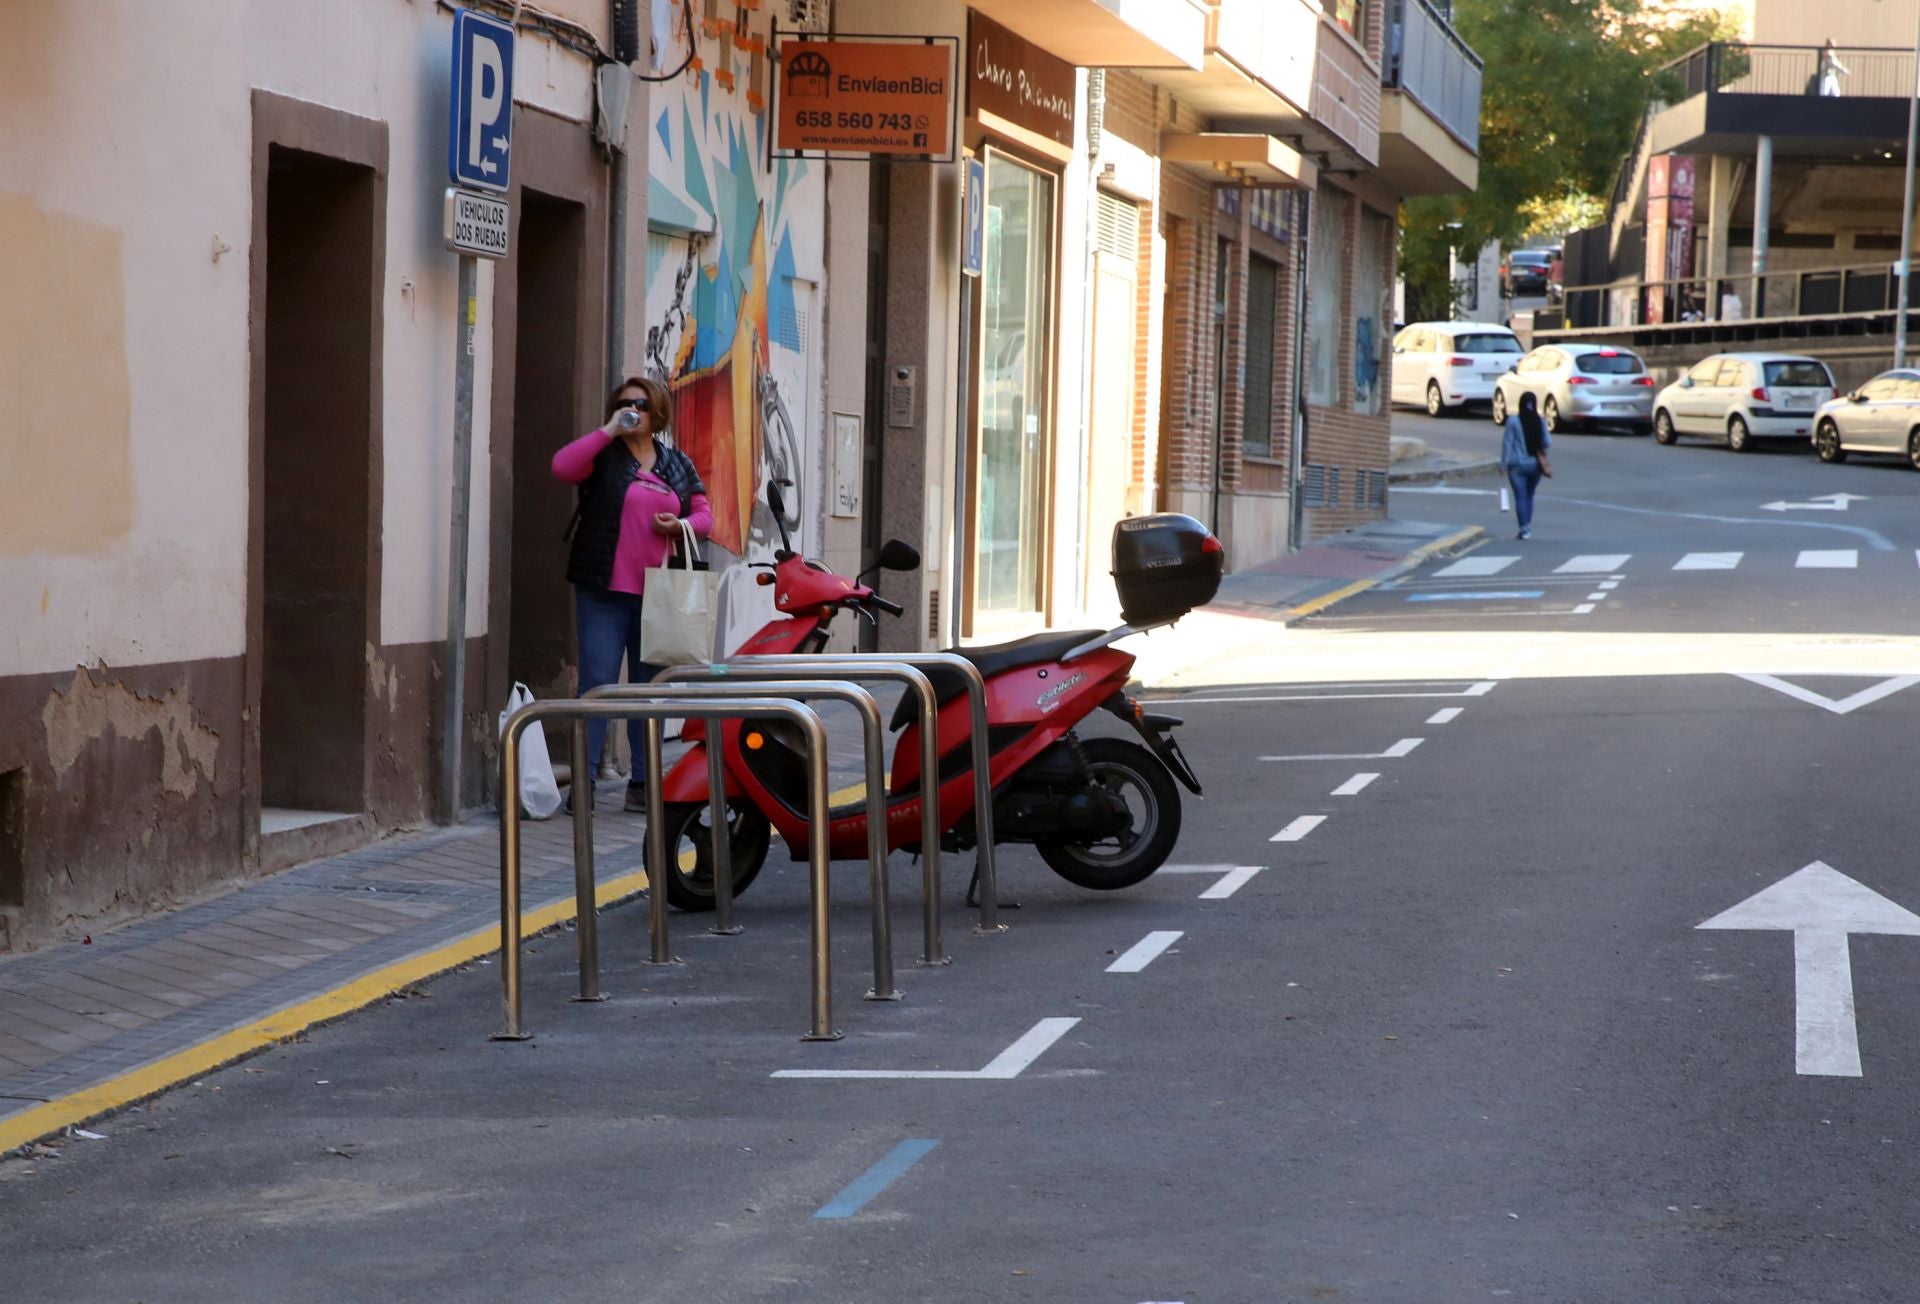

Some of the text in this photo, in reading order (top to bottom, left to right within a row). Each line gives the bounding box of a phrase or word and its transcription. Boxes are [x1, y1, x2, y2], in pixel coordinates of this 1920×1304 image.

[976, 39, 1012, 92] Charo
[837, 74, 943, 95] EnvíaenBici
[469, 33, 504, 167] P
[796, 111, 912, 130] 658 560 743
[460, 200, 504, 226] VEHICULOS
[970, 175, 980, 256] P
[455, 222, 506, 249] DOS RUEDAS
